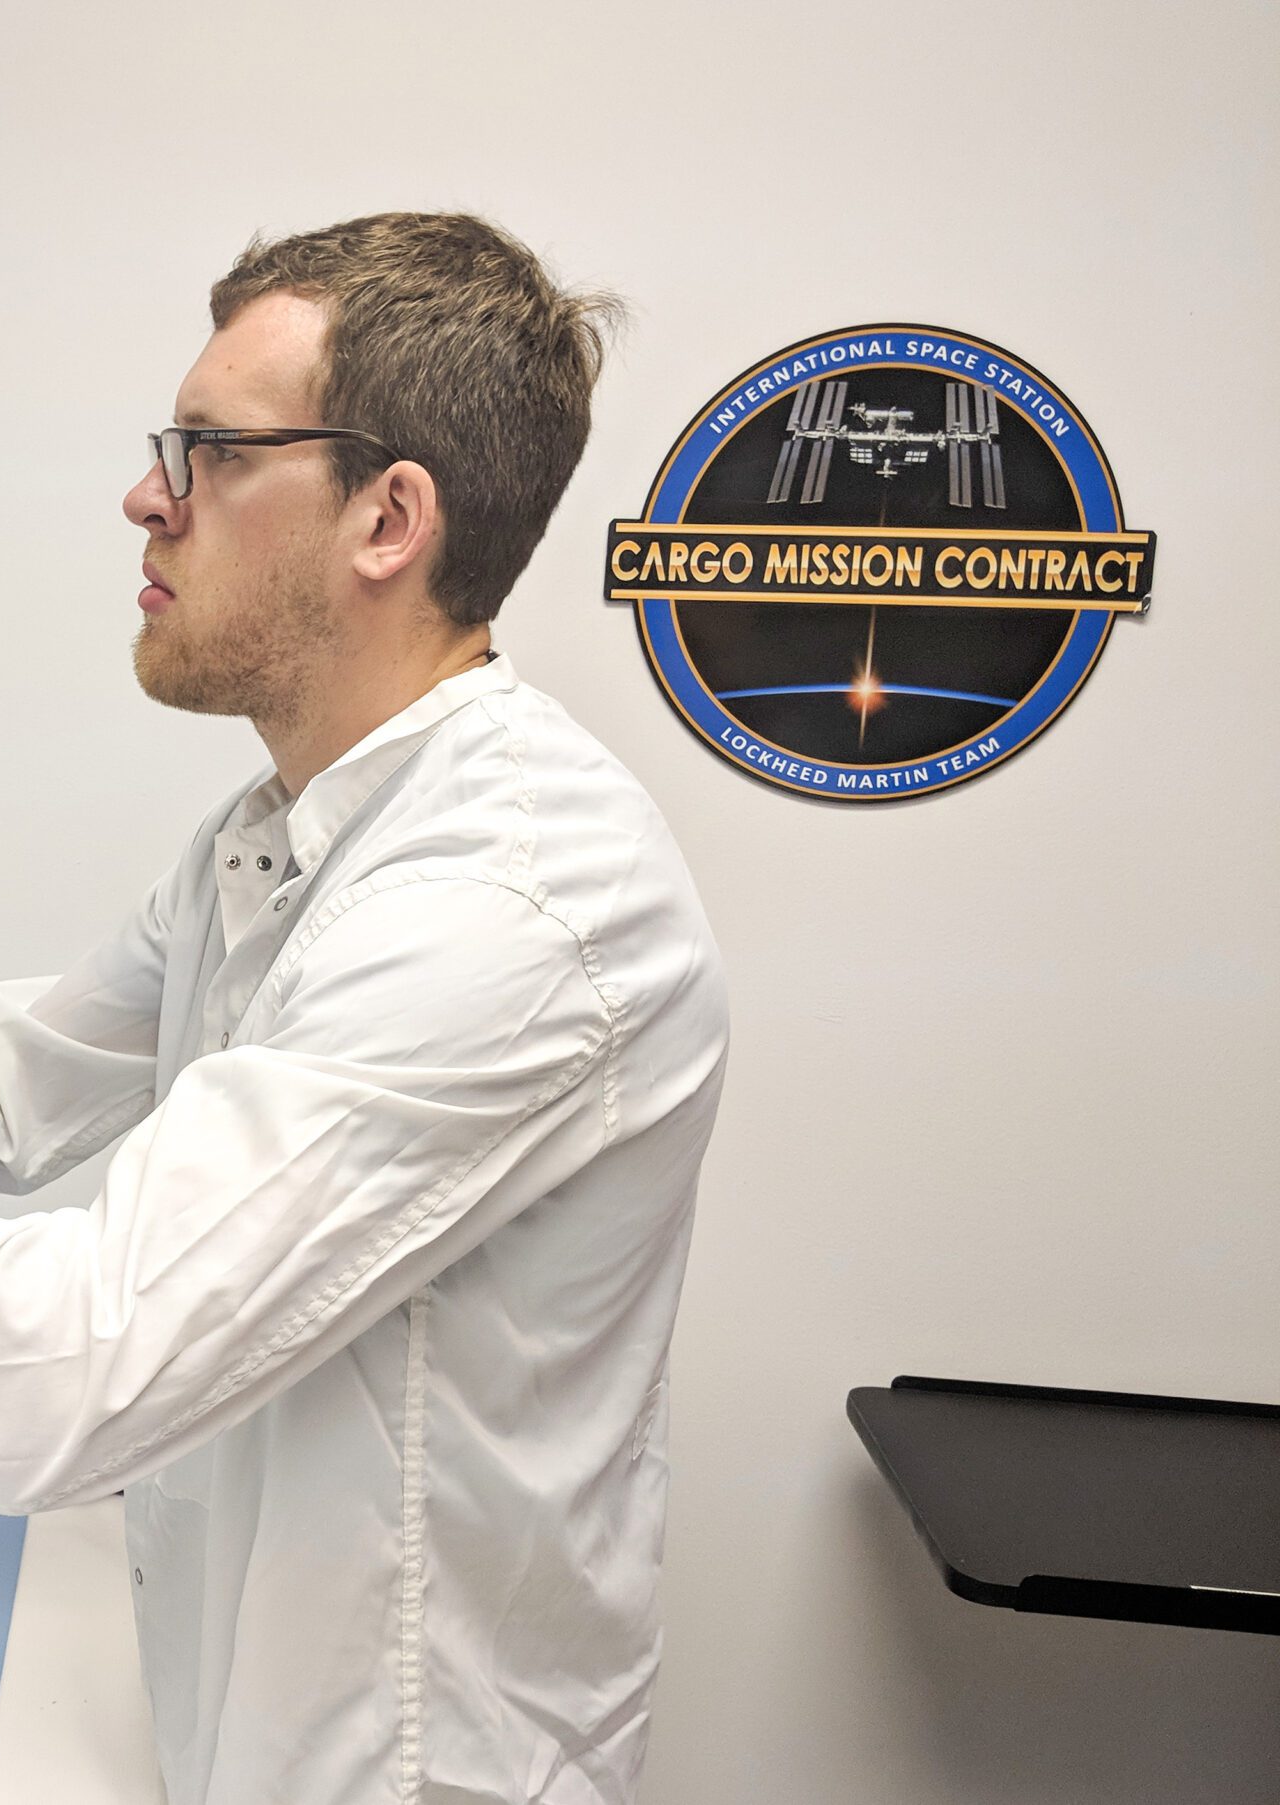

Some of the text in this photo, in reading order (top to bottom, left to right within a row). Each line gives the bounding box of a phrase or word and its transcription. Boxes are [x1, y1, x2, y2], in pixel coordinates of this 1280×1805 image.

[709, 340, 1069, 437] INTERNATIONAL SPACE STATION
[611, 541, 1144, 593] CARGO MISSION CONTRACT
[720, 727, 1001, 789] LOCKHEED MARTIN TEAM
